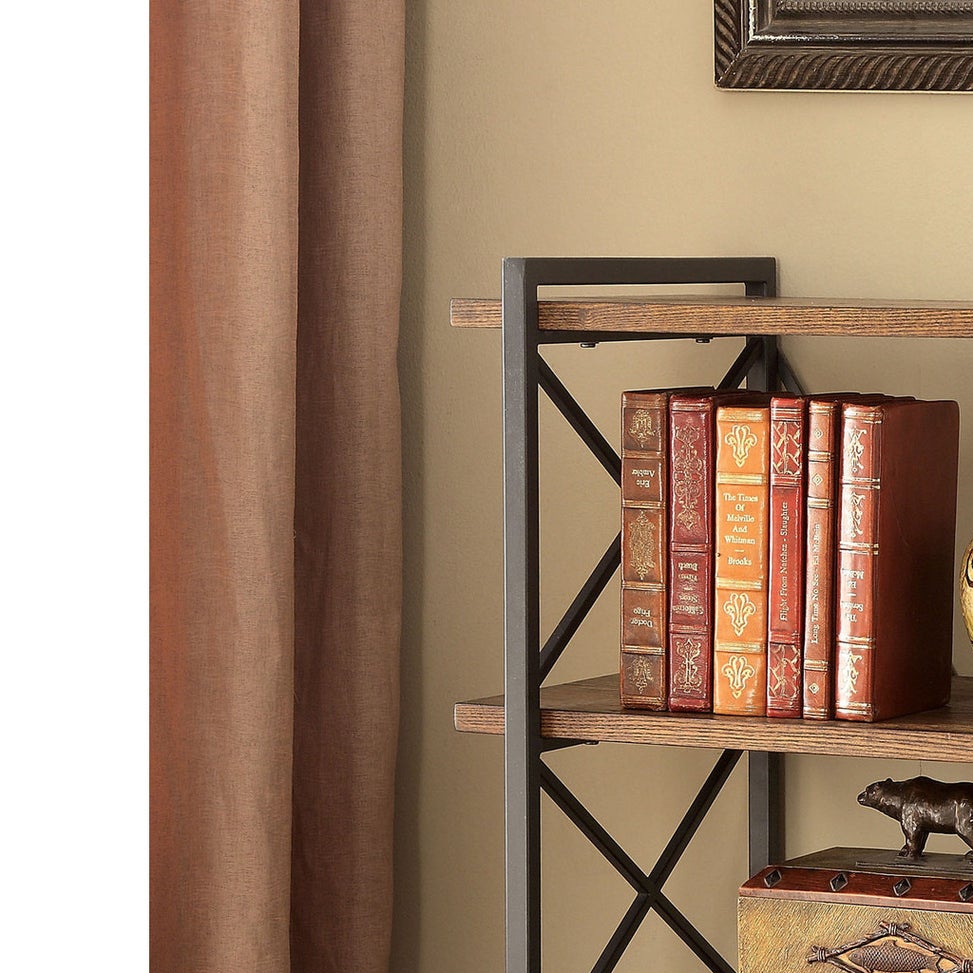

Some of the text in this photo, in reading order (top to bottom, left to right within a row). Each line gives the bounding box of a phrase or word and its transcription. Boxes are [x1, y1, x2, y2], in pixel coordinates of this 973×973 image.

[723, 492, 758, 502] The Times
[735, 503, 746, 511] Of
[727, 513, 755, 522] Melville
[781, 502, 790, 536] Slaughter
[732, 525, 748, 533] And
[724, 535, 756, 544] Whitman
[727, 556, 752, 566] Brooks
[780, 544, 789, 575] Natchez
[780, 578, 788, 599] From
[811, 589, 818, 602] No
[780, 600, 789, 622] Flight
[811, 601, 819, 622] Time
[811, 626, 820, 645] Long
